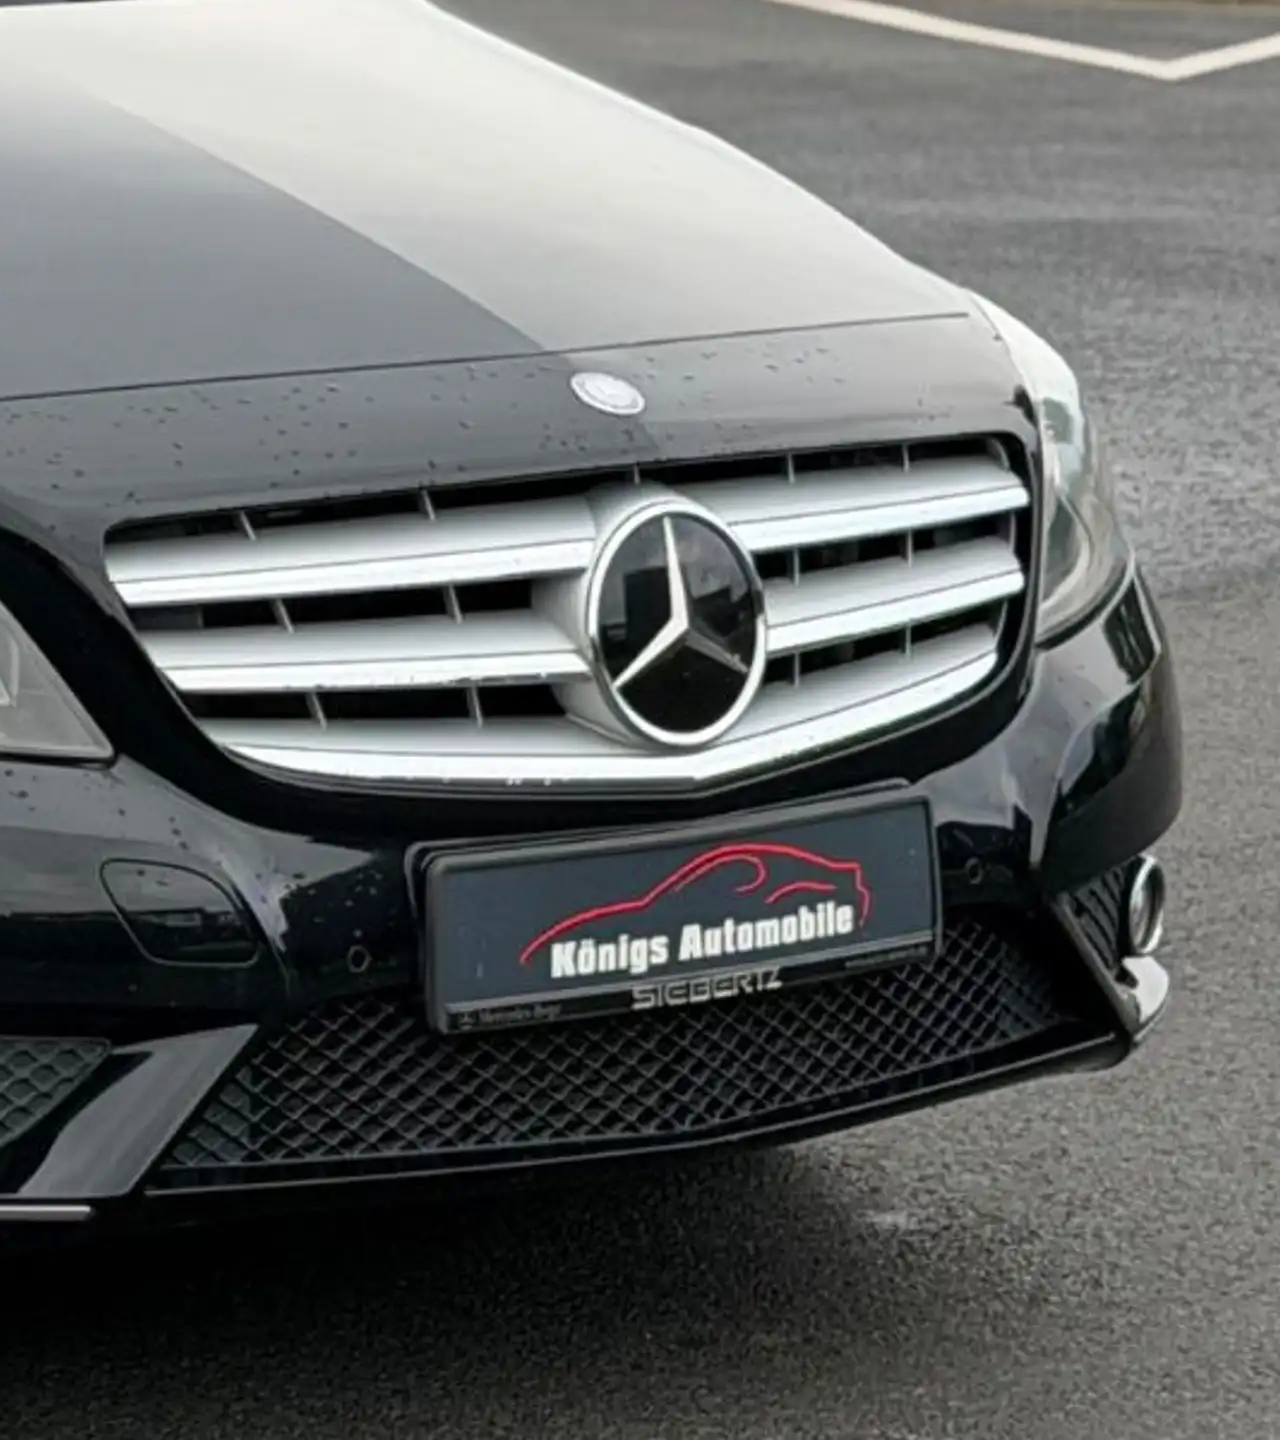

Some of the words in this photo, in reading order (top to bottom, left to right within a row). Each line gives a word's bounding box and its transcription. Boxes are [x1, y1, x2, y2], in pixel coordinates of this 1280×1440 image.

[550, 931, 670, 979] Königs
[678, 902, 855, 961] Automobile
[630, 963, 783, 1011] SIEBERTZ
